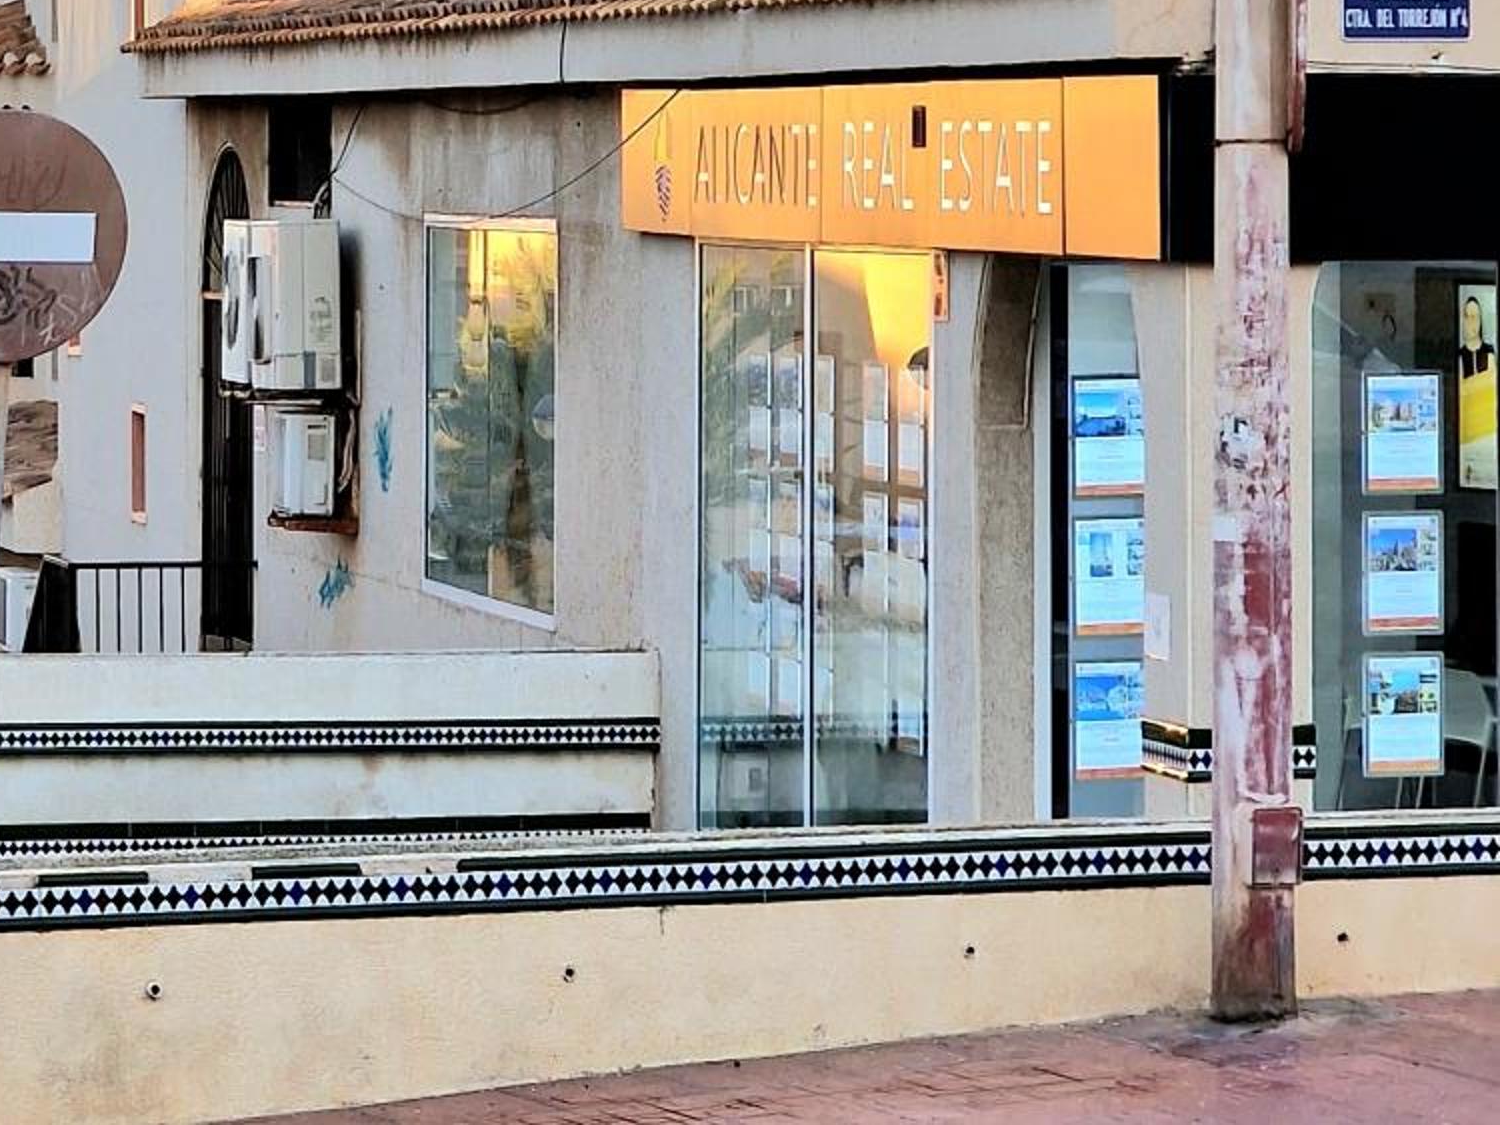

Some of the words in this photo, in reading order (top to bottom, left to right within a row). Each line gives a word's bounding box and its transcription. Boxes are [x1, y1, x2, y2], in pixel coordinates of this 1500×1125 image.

[1376, 8, 1396, 28] DEL
[841, 121, 916, 213] REAL
[939, 119, 1053, 217] ESTATE
